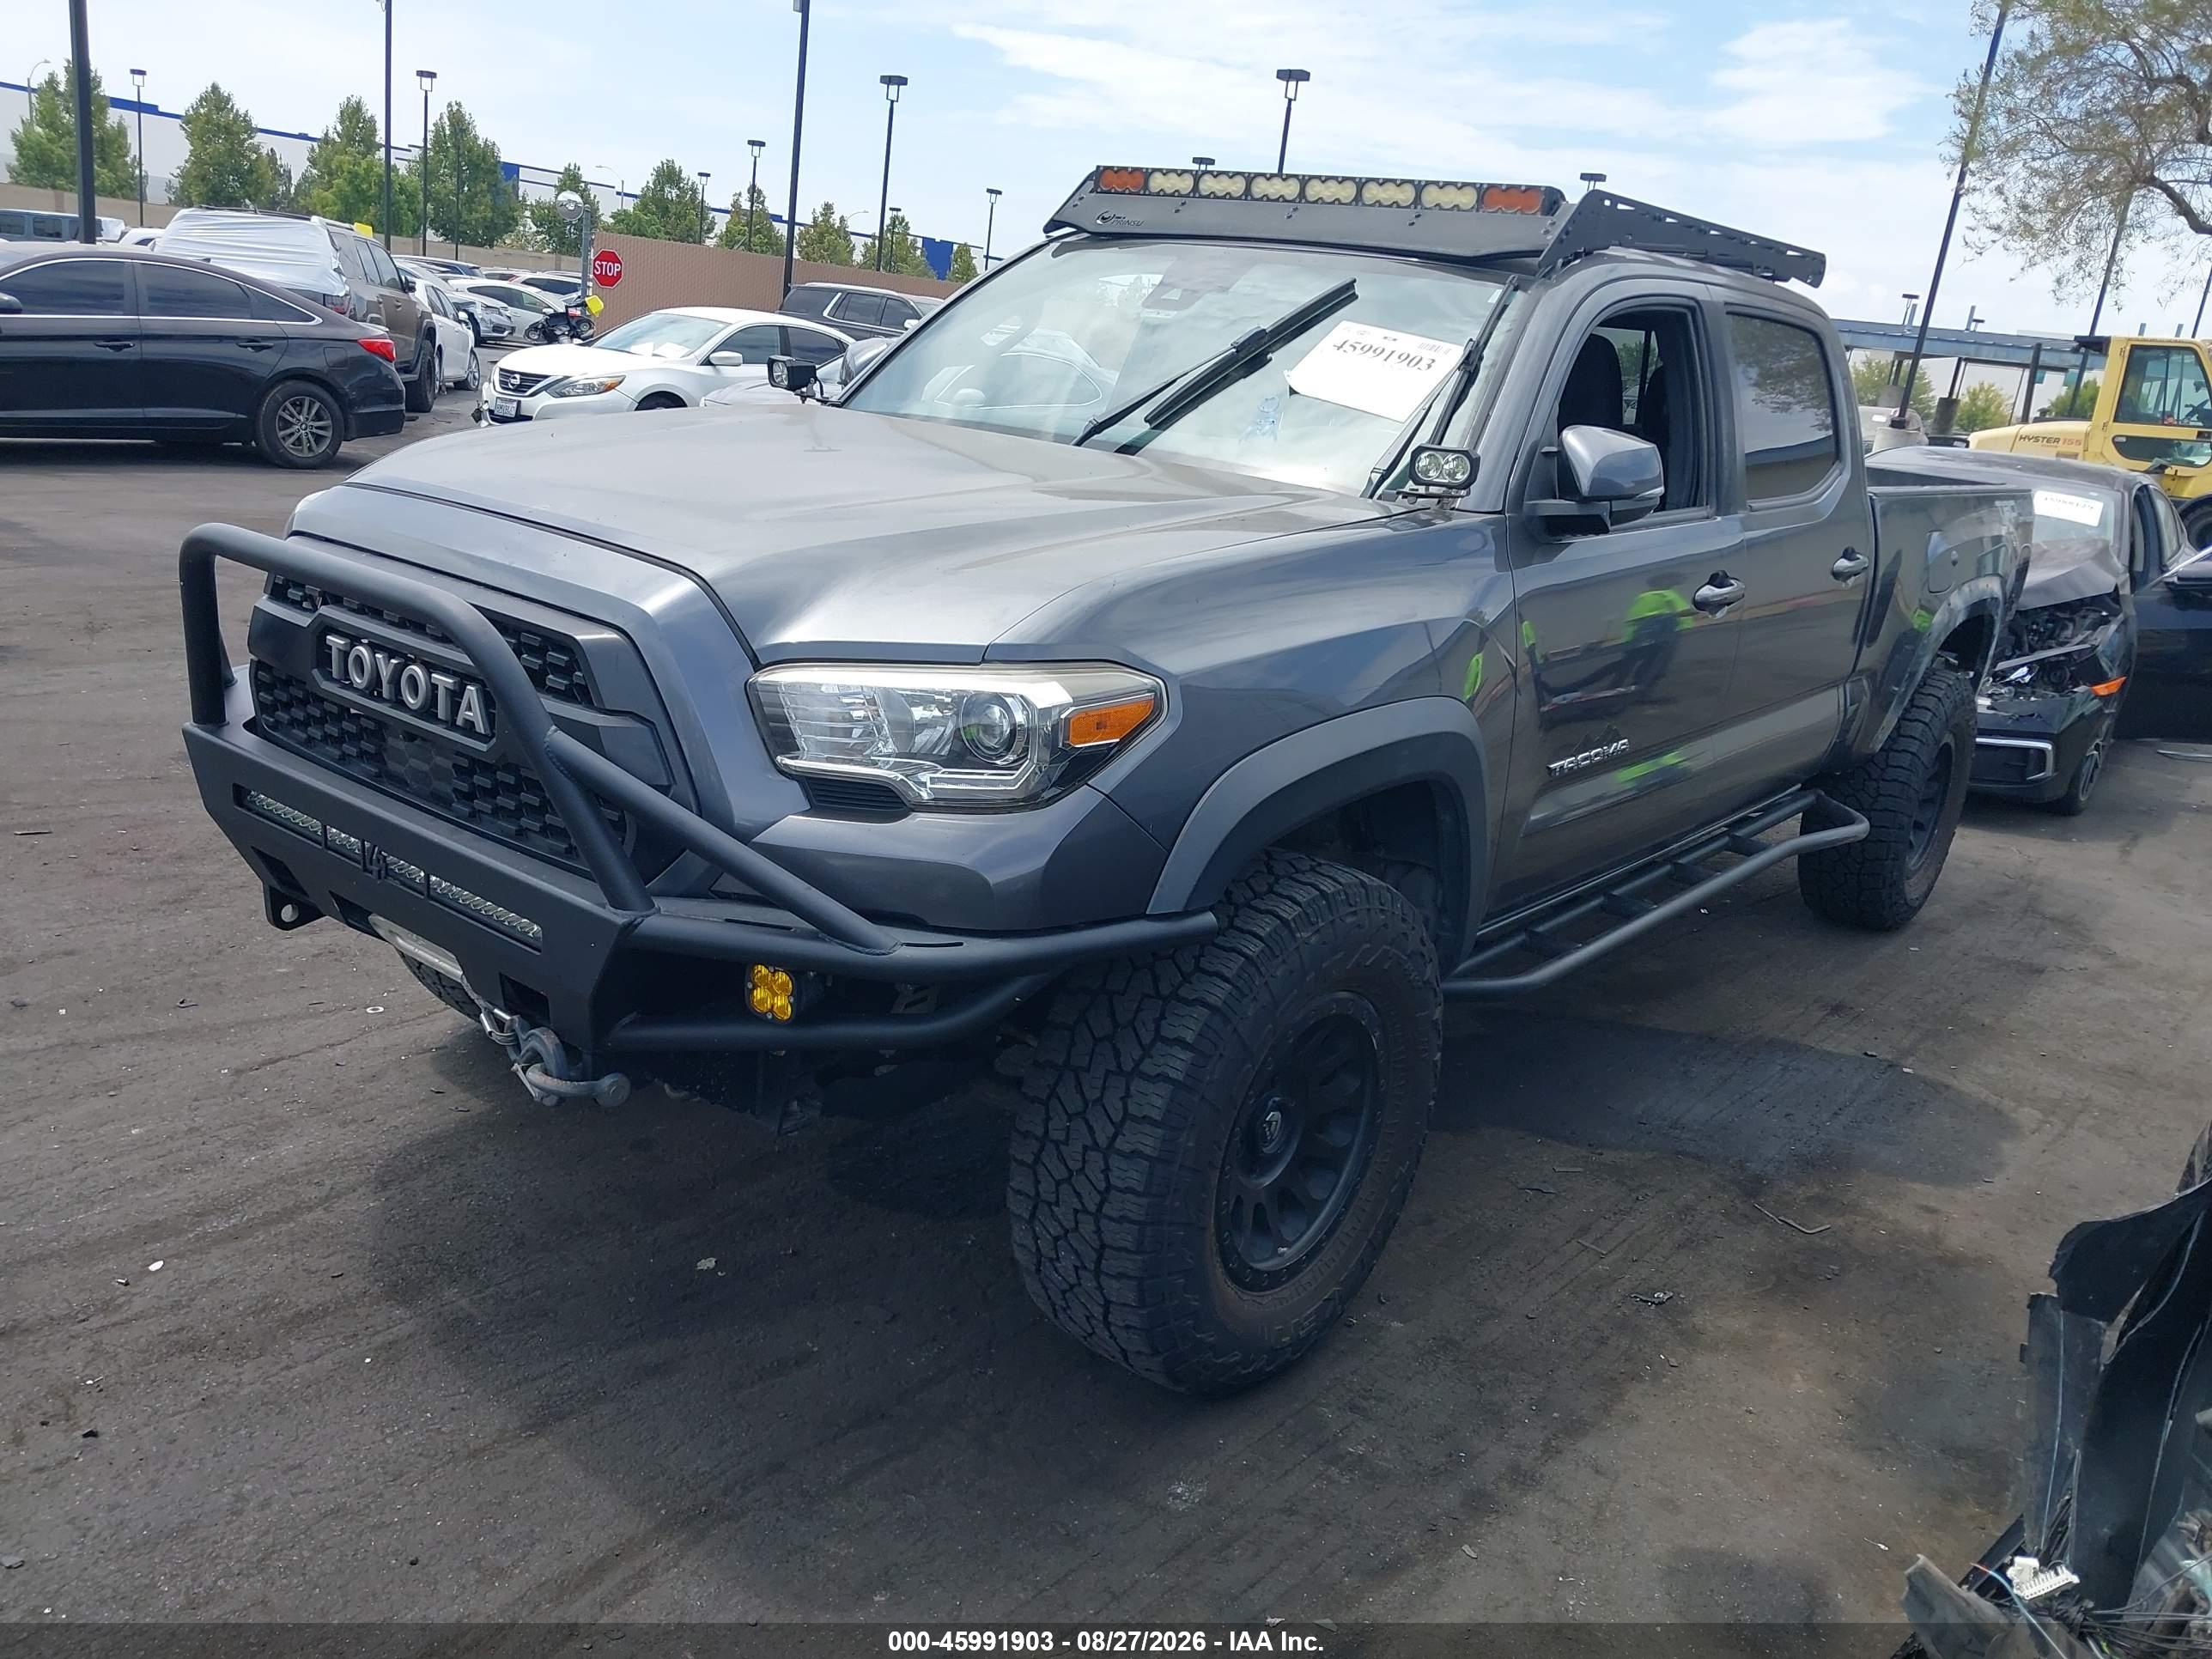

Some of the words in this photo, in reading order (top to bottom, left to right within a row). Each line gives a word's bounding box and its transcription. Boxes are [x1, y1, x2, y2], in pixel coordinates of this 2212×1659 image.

[594, 260, 621, 276] STOP
[1332, 338, 1437, 371] 45991903
[2019, 434, 2061, 445] HYSTER
[325, 635, 494, 737] TOYOTA
[1547, 738, 1629, 775] TACOMA
